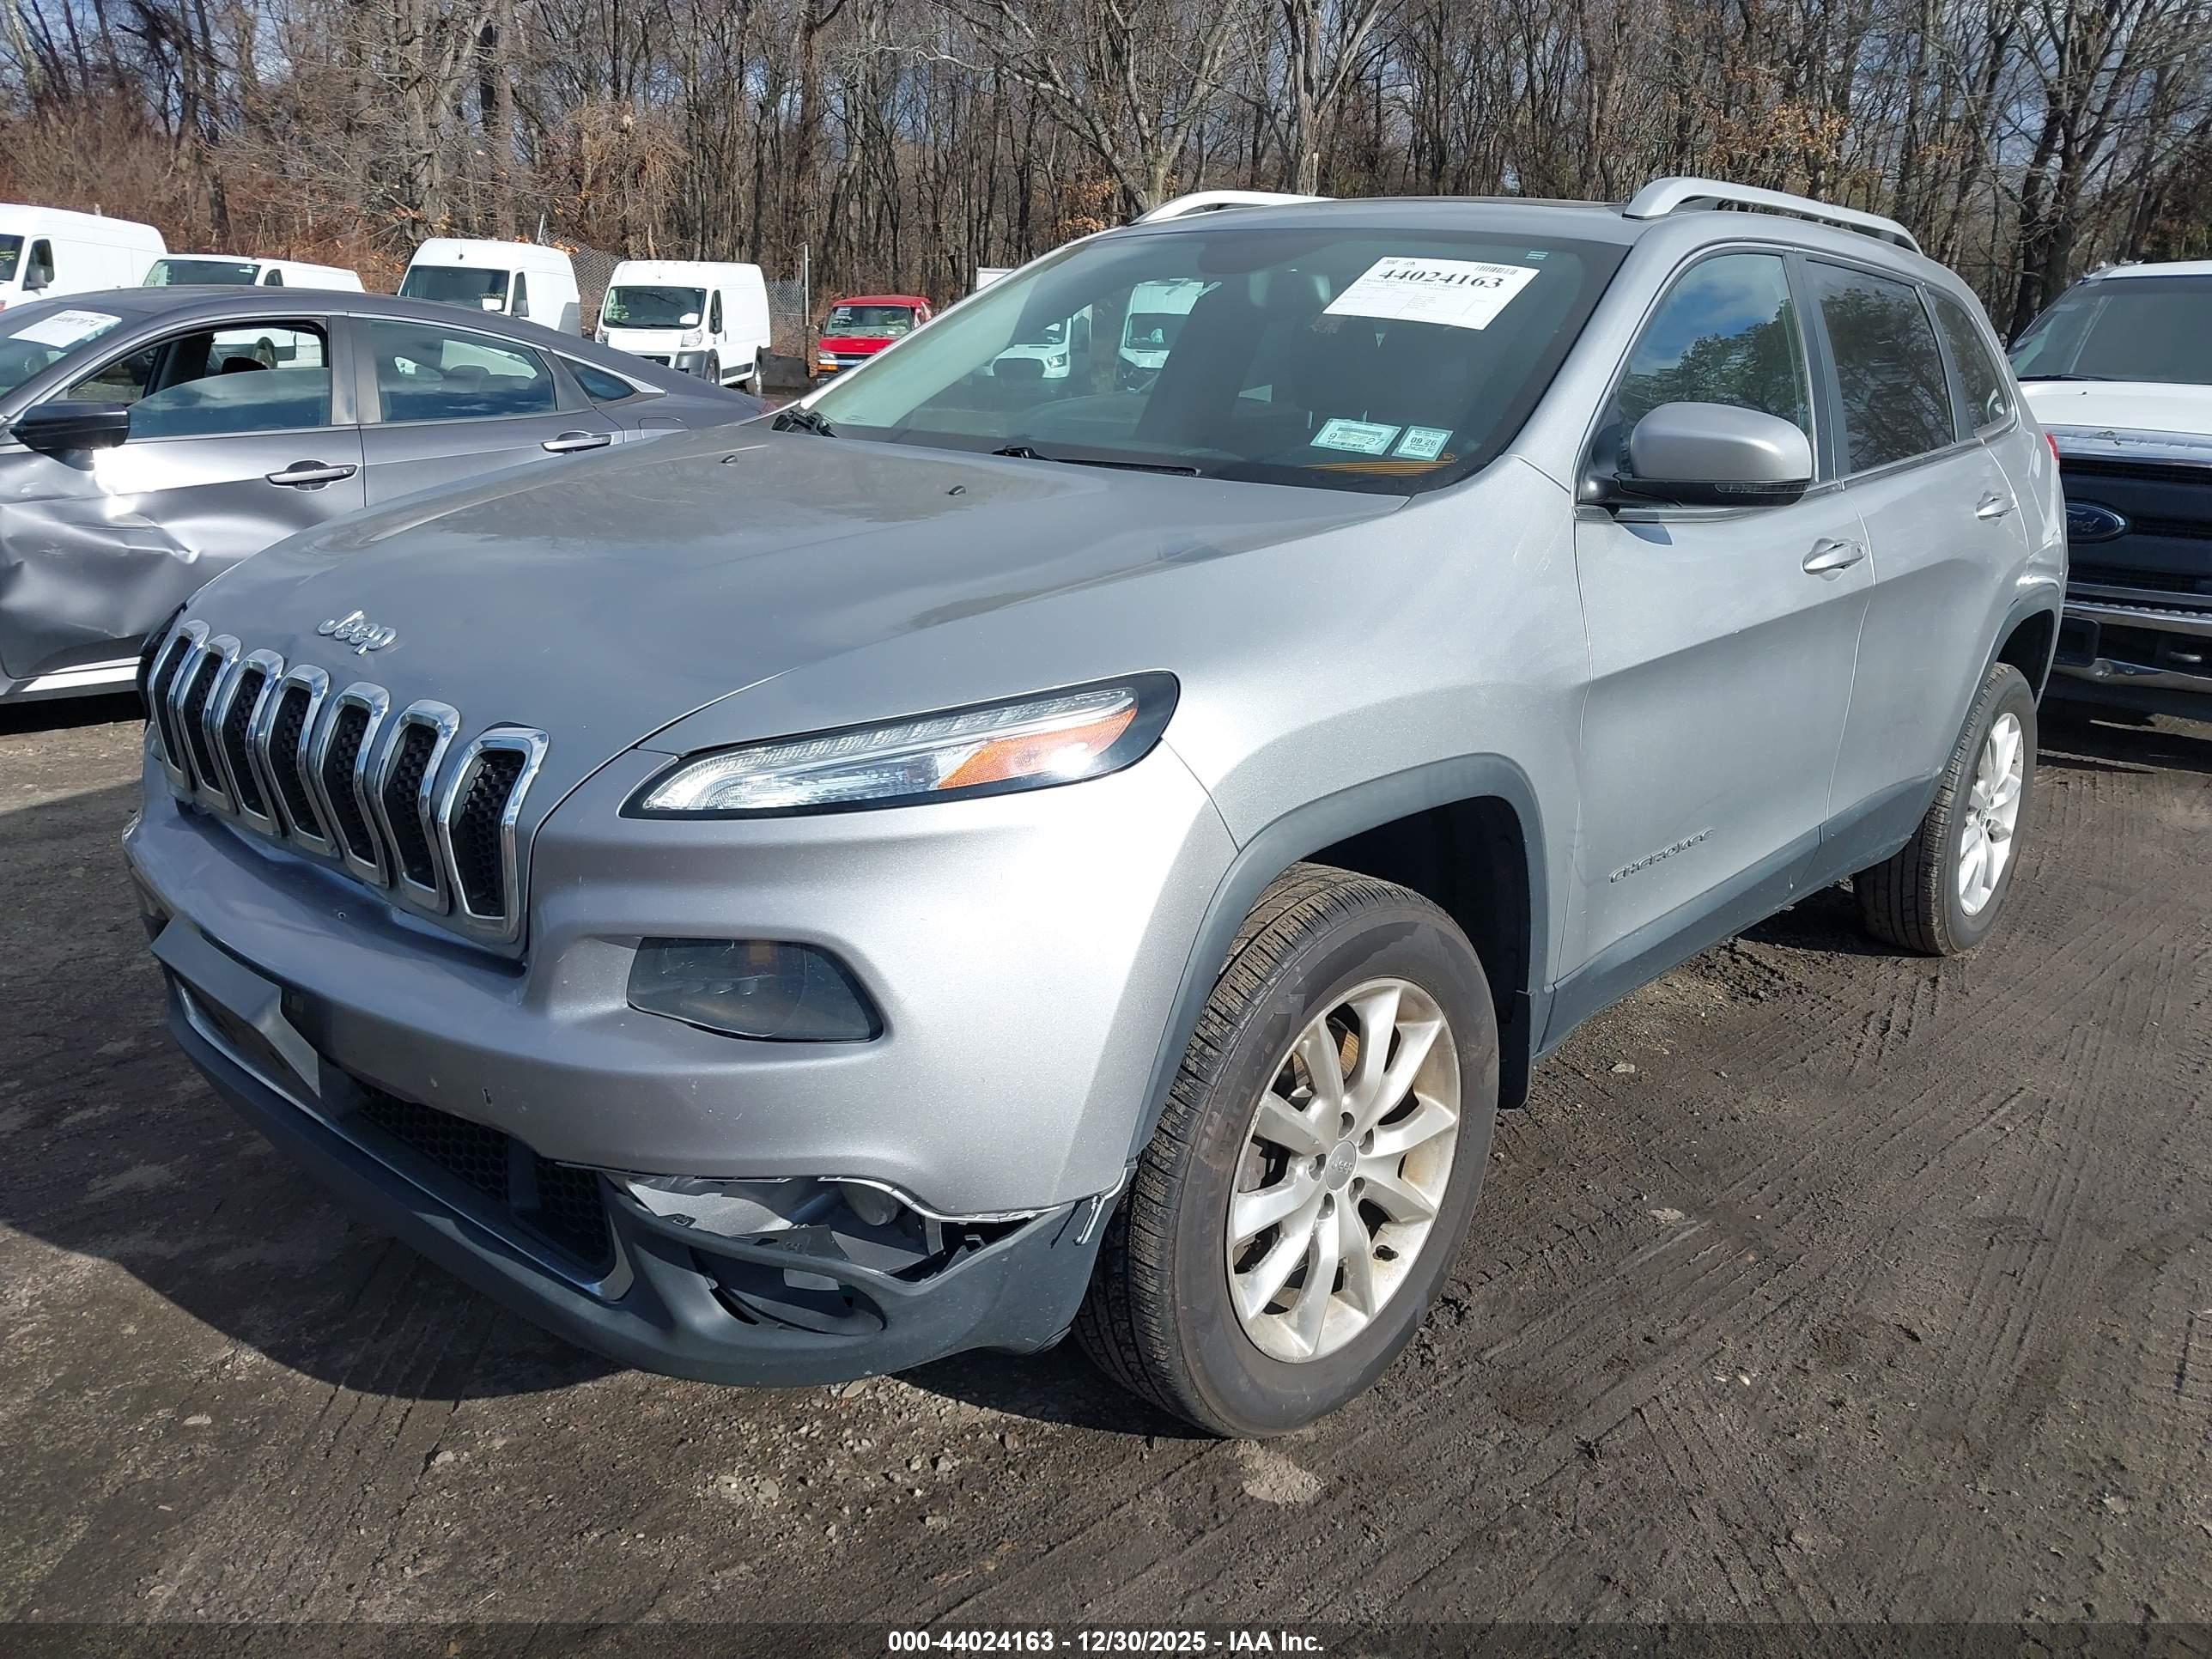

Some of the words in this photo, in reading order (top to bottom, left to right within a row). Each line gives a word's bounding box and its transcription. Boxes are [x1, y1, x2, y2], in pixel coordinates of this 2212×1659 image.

[1378, 269, 1504, 289] 44024163
[1365, 437, 1385, 446] 27
[317, 610, 398, 655] Jeep
[1610, 826, 1716, 884] CHEROKEE
[1331, 1156, 1353, 1175] Jeep
